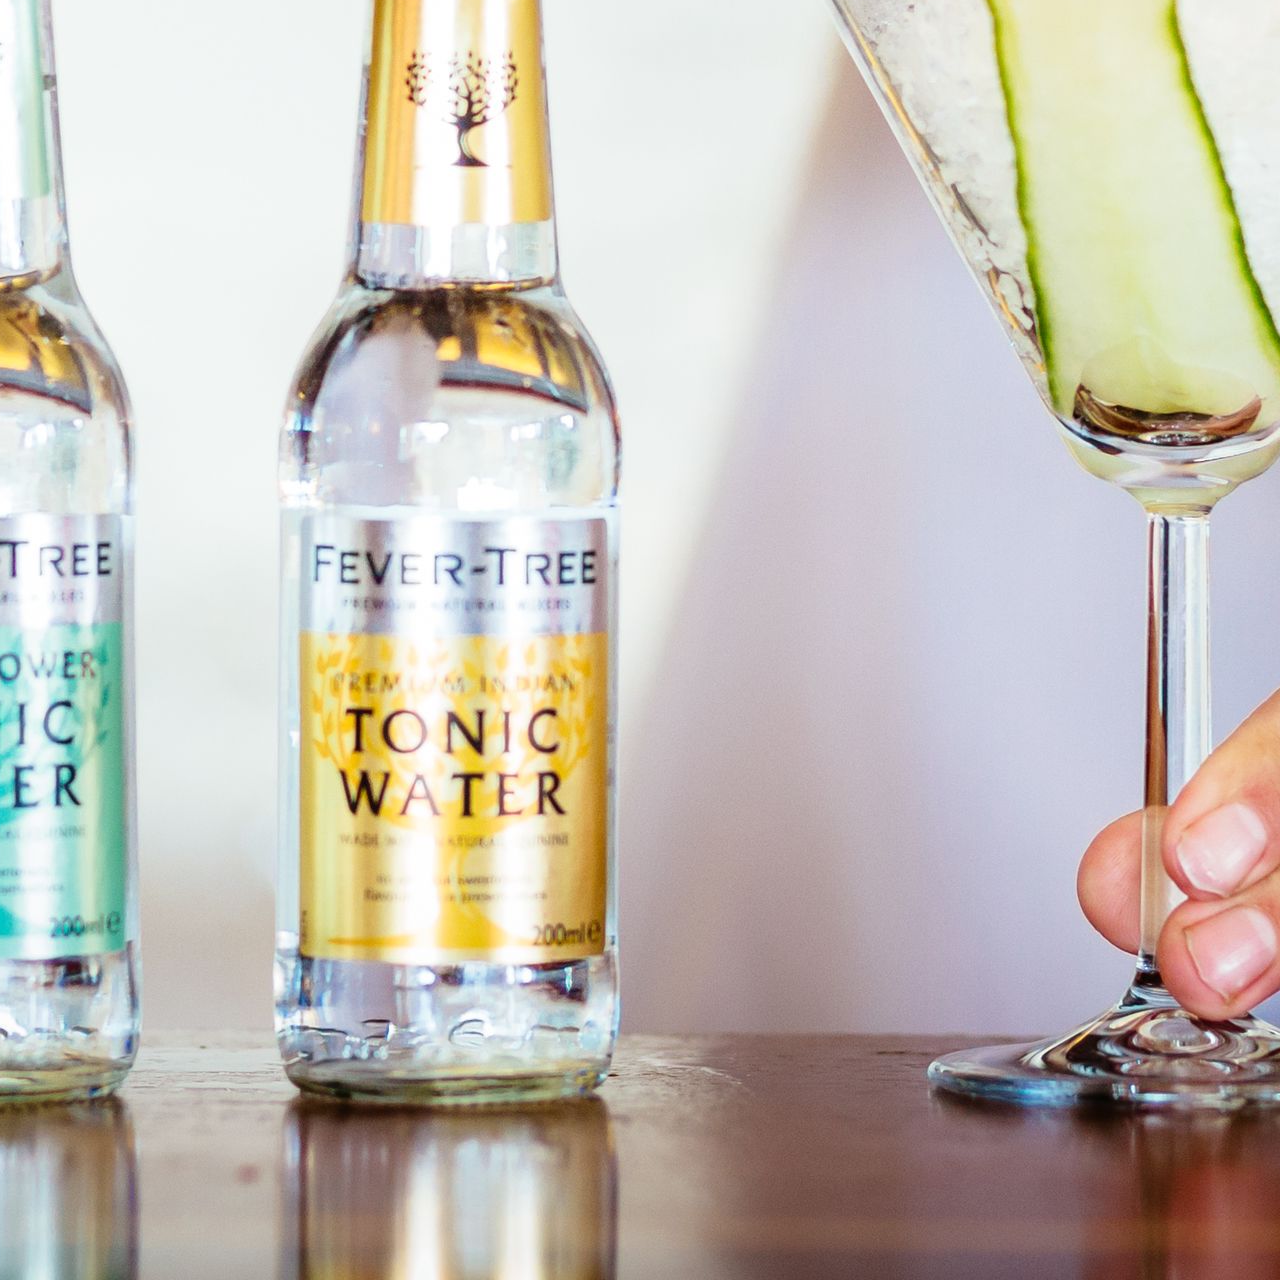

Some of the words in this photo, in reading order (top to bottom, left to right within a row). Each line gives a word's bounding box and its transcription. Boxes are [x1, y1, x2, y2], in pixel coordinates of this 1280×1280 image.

[314, 545, 597, 587] FEVER-TREE
[345, 707, 561, 755] TONIC
[339, 770, 567, 818] WATER
